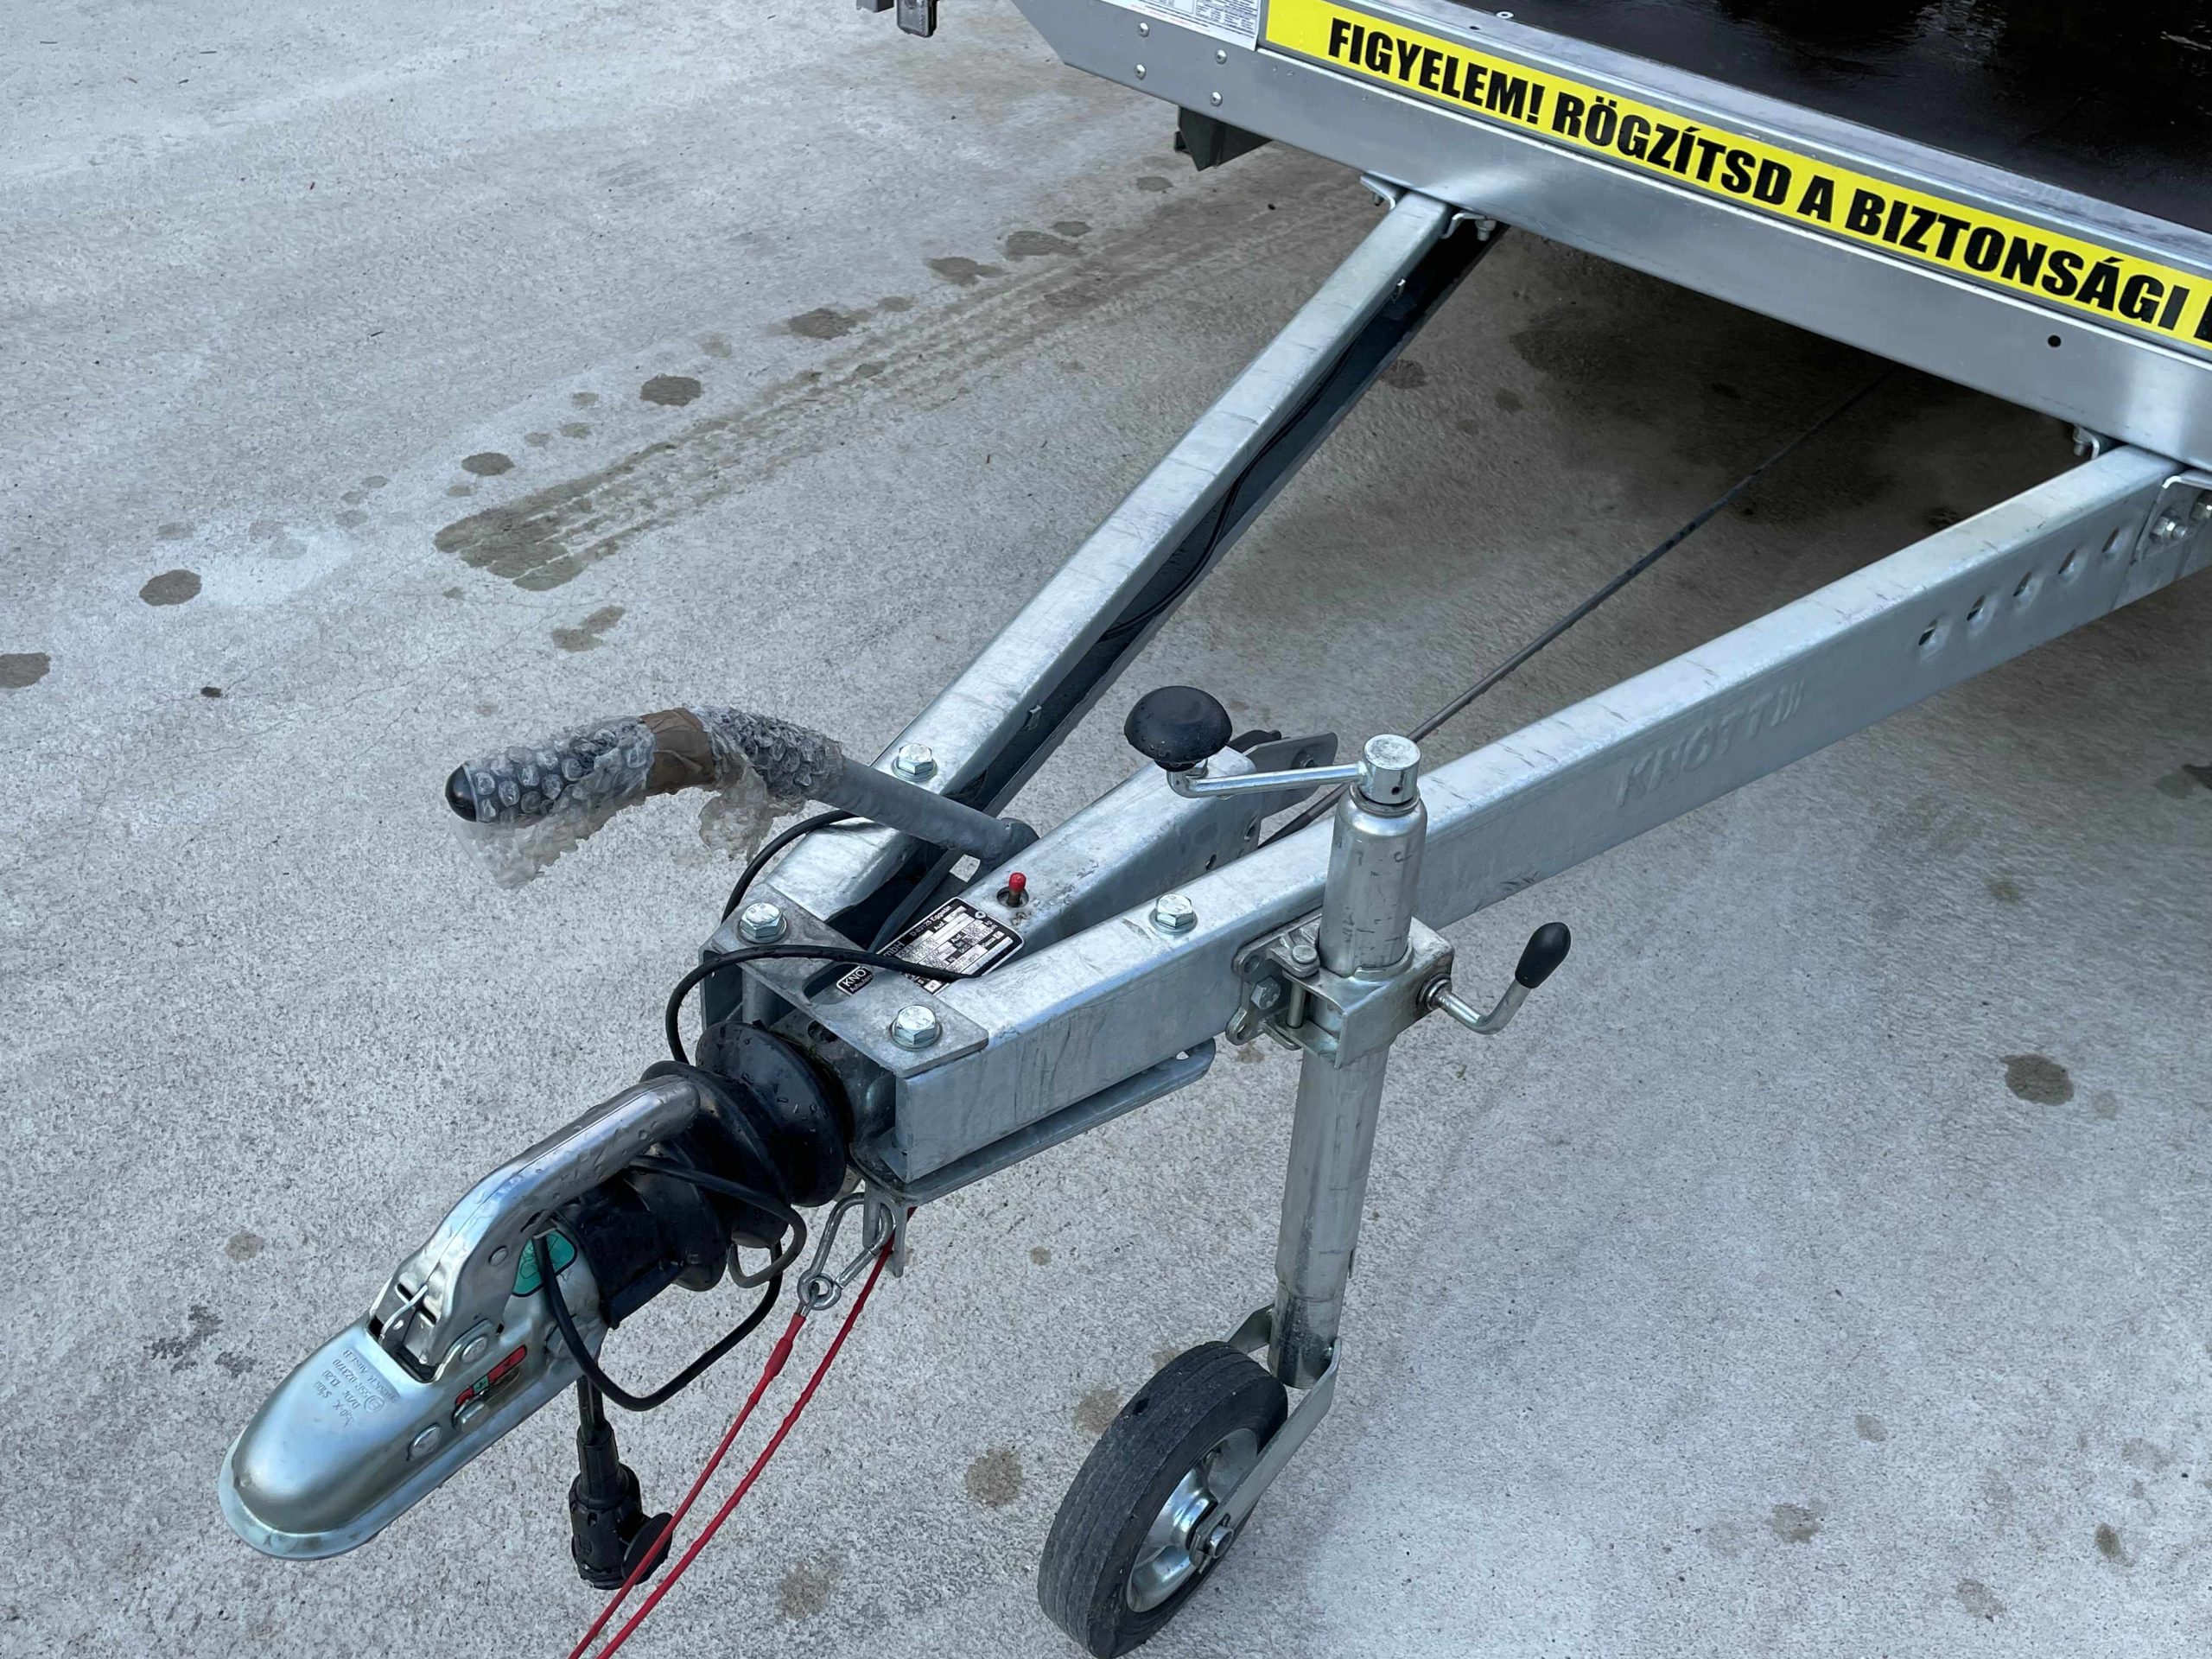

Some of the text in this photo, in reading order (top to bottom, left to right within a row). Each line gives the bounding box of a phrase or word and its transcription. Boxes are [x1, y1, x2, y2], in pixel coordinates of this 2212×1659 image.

[1329, 17, 1546, 124] FIGYELEM!
[1552, 92, 1792, 206] RÖGZÍTSD
[1796, 175, 1834, 223] A
[1845, 188, 2190, 331] BIZTONSÁGI
[842, 965, 869, 987] KNO
[883, 939, 905, 957] mbH
